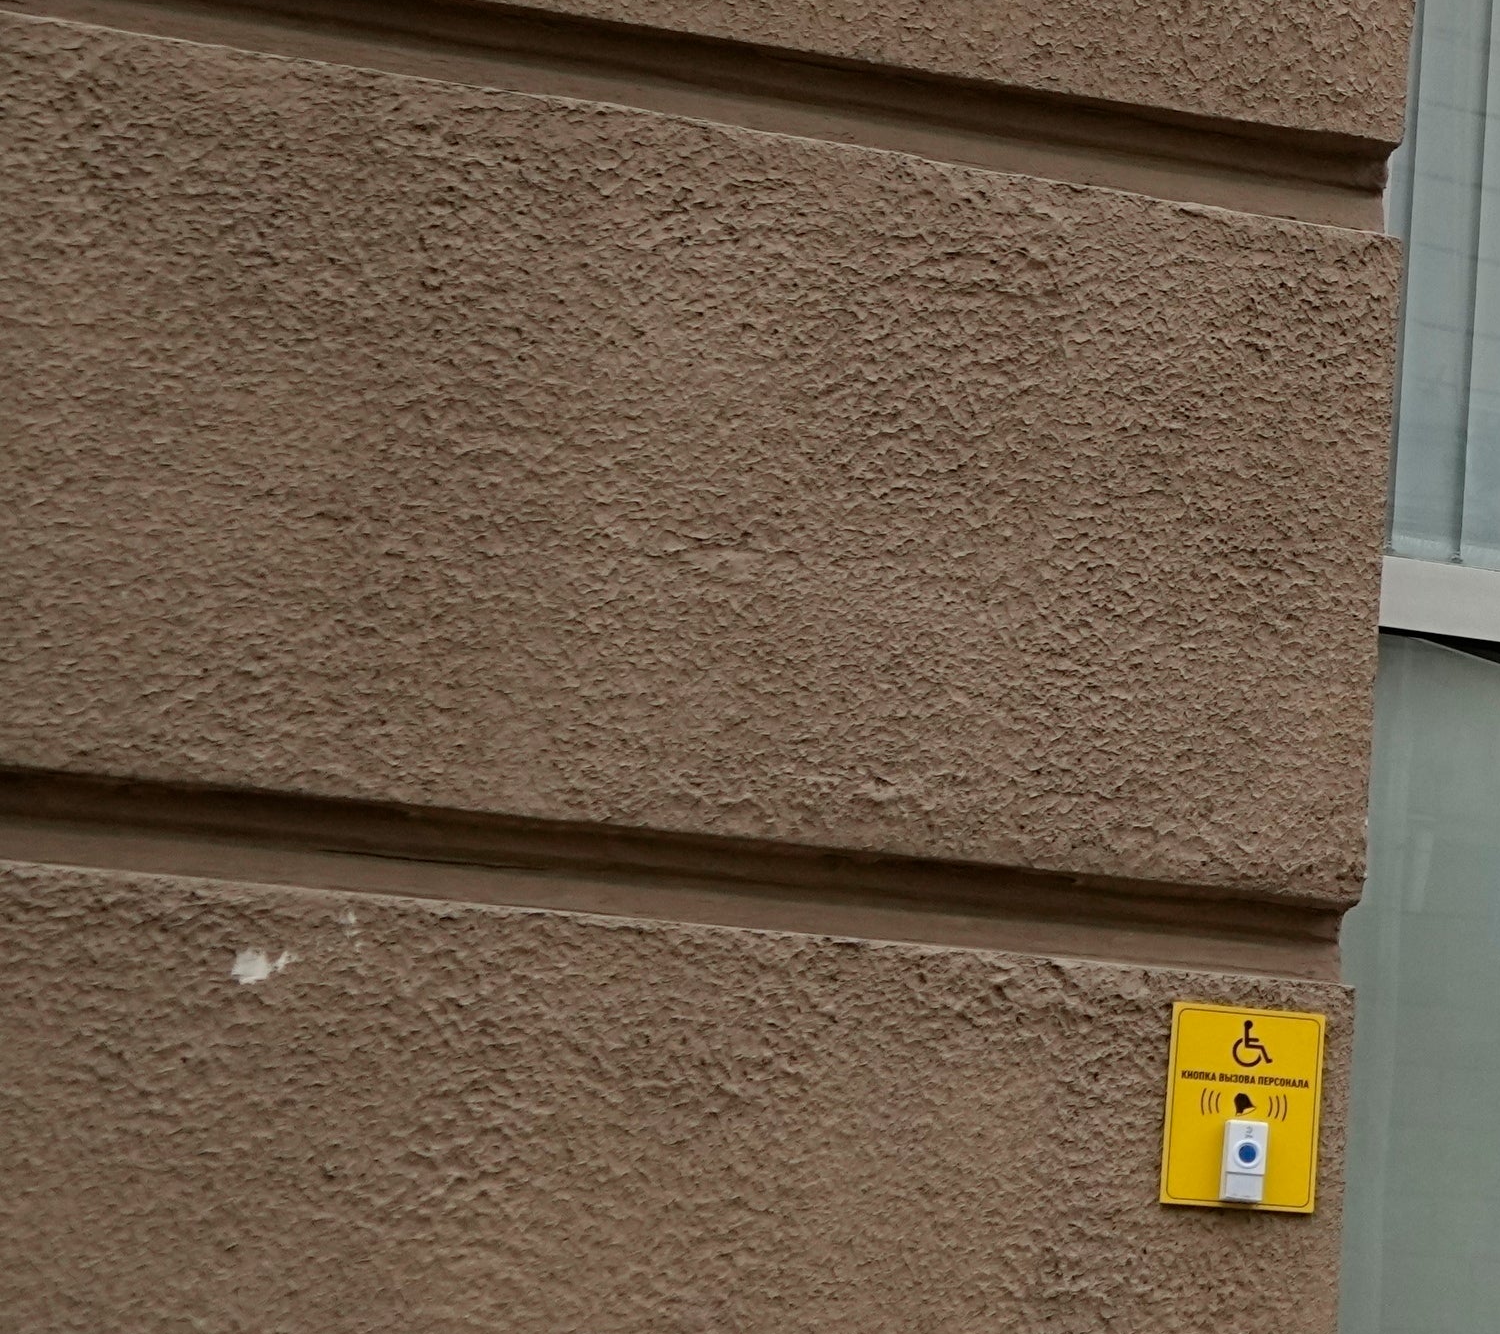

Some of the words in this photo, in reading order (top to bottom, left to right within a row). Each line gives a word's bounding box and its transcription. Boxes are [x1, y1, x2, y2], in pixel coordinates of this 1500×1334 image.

[1181, 1070, 1216, 1082] КНОПКА
[1218, 1073, 1255, 1085] ВЫЗОВА
[1257, 1076, 1309, 1089] ПЕРСОНАЛА
